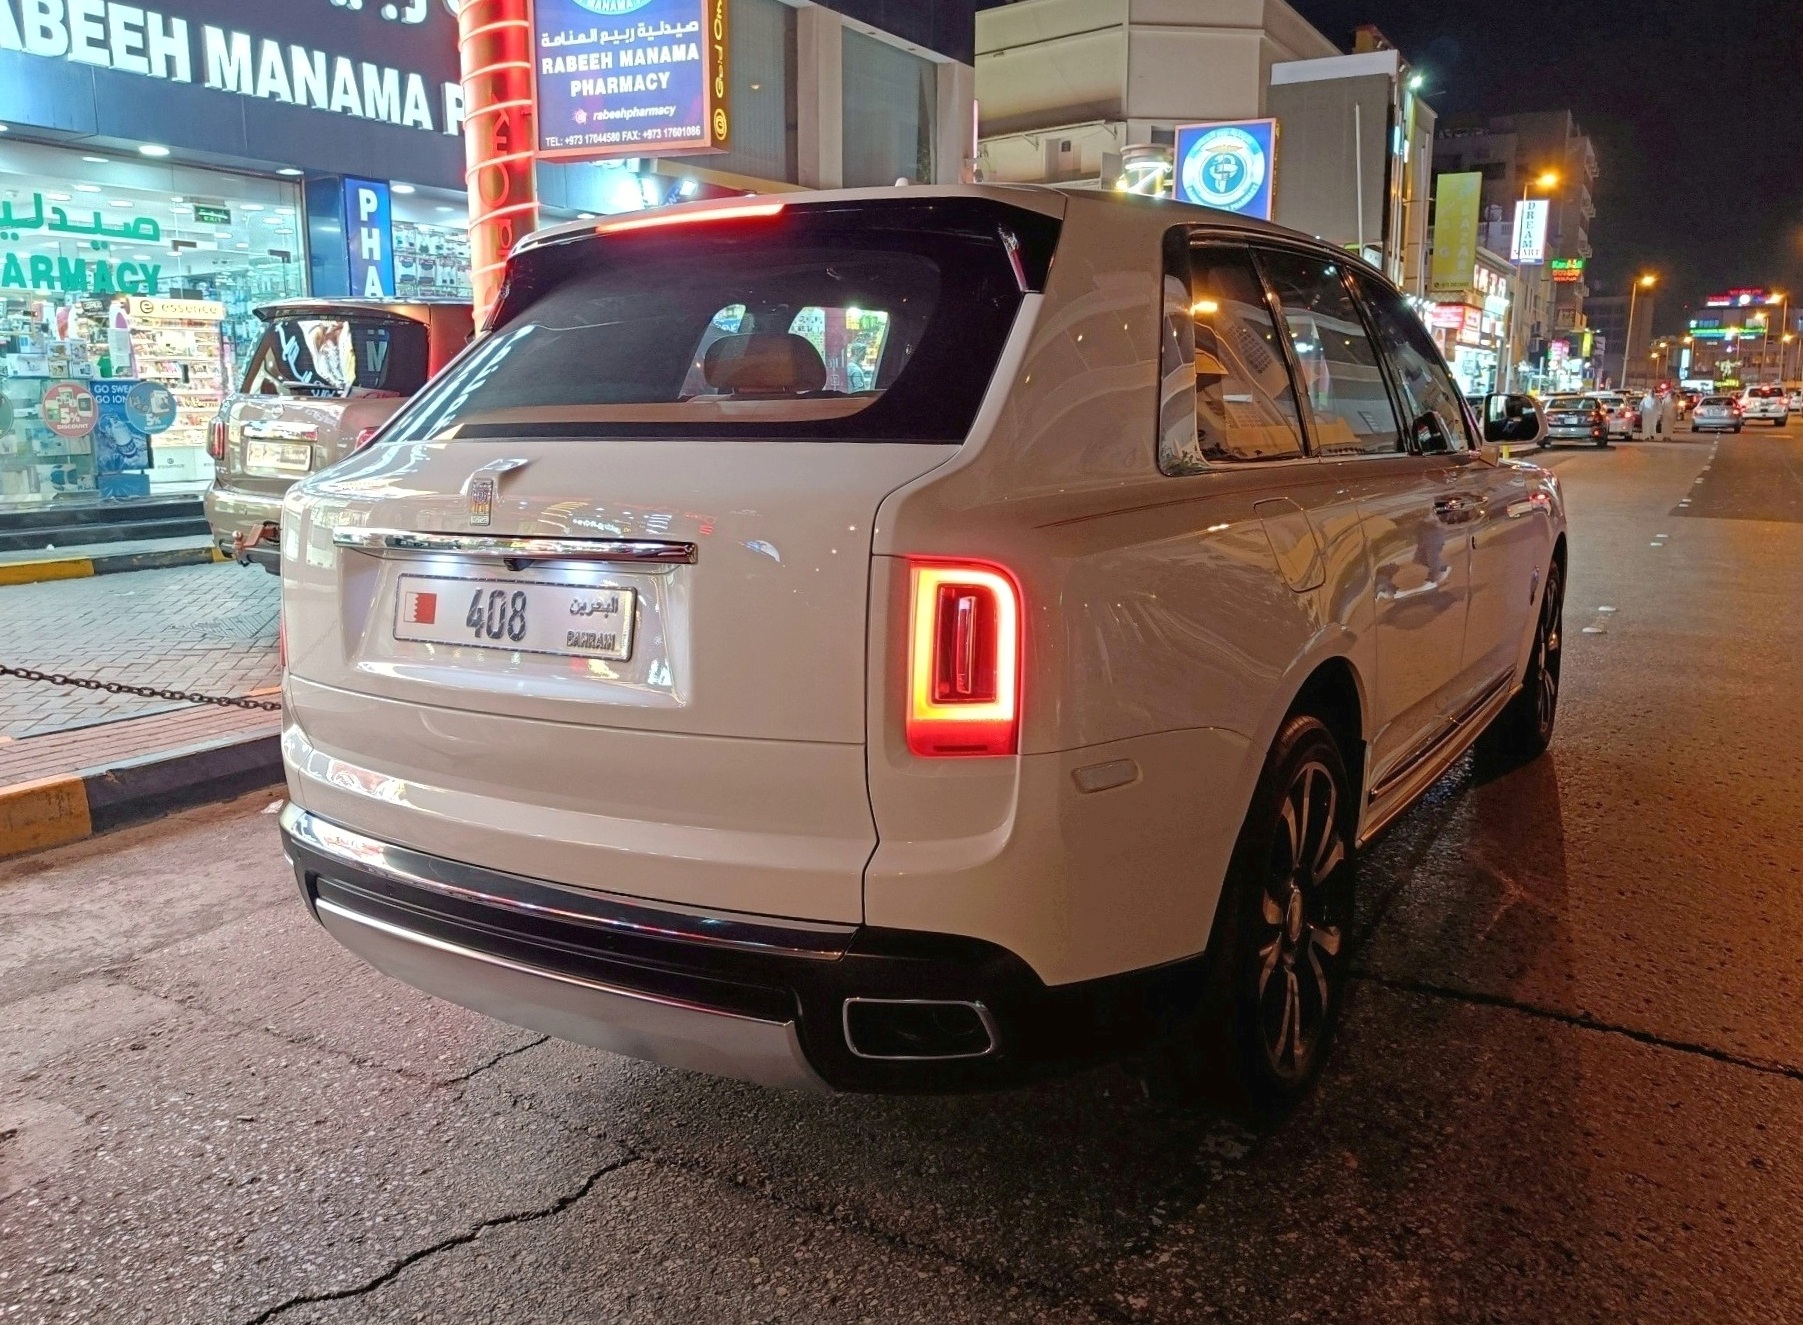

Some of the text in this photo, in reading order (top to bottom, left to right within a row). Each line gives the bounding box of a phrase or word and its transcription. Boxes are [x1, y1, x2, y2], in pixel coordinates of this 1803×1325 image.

[541, 20, 699, 47] صيدلية ربيع المنامة
[541, 43, 699, 74] RABEEH MANAMA
[202, 24, 434, 131] MANAMA
[570, 71, 671, 97] PHARMACY
[592, 105, 676, 121] rabeehpharmacy
[545, 137, 563, 147] TEL:
[564, 134, 583, 146] +973
[621, 130, 641, 142] FAX:
[643, 128, 661, 139] +973
[1522, 202, 1536, 248] DREAM
[1, 253, 162, 296] ARMACY
[161, 303, 218, 314] essence
[94, 384, 110, 394] GO
[95, 395, 111, 404] GO
[60, 408, 80, 424] 5%
[465, 587, 527, 642] 408
[569, 596, 619, 619] البحرين
[566, 630, 616, 651] BAHRAIN
